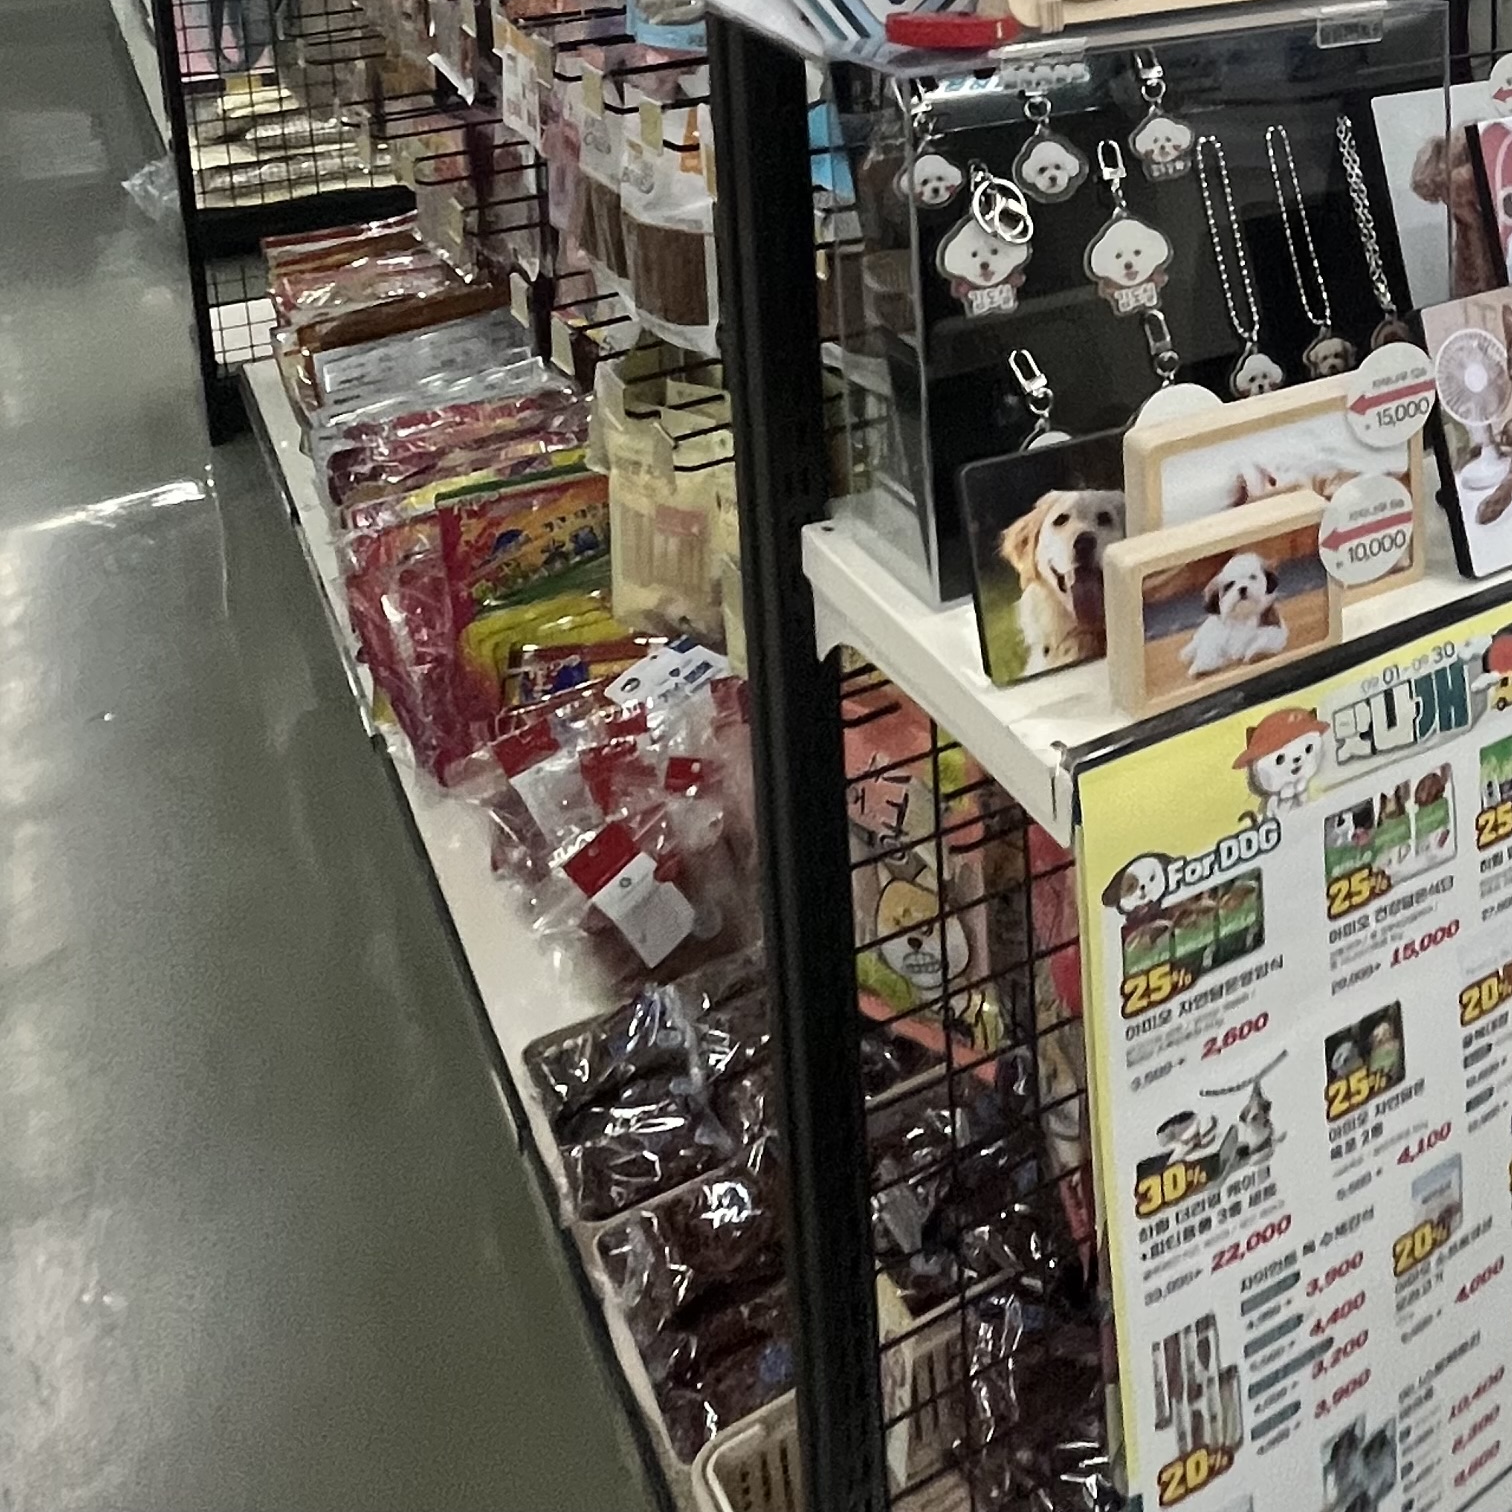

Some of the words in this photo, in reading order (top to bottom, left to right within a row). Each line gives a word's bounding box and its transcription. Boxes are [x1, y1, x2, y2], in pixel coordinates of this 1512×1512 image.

[1375, 395, 1430, 428] 15,000
[1166, 856, 1217, 892] For
[1217, 819, 1282, 873] DOG
[1328, 868, 1391, 918] 25%
[1125, 965, 1193, 1016] 25%
[1328, 1064, 1388, 1118] 25%
[1136, 1161, 1207, 1218] 30%
[1210, 1213, 1292, 1276] 22,000
[1159, 1445, 1233, 1506] 20%
